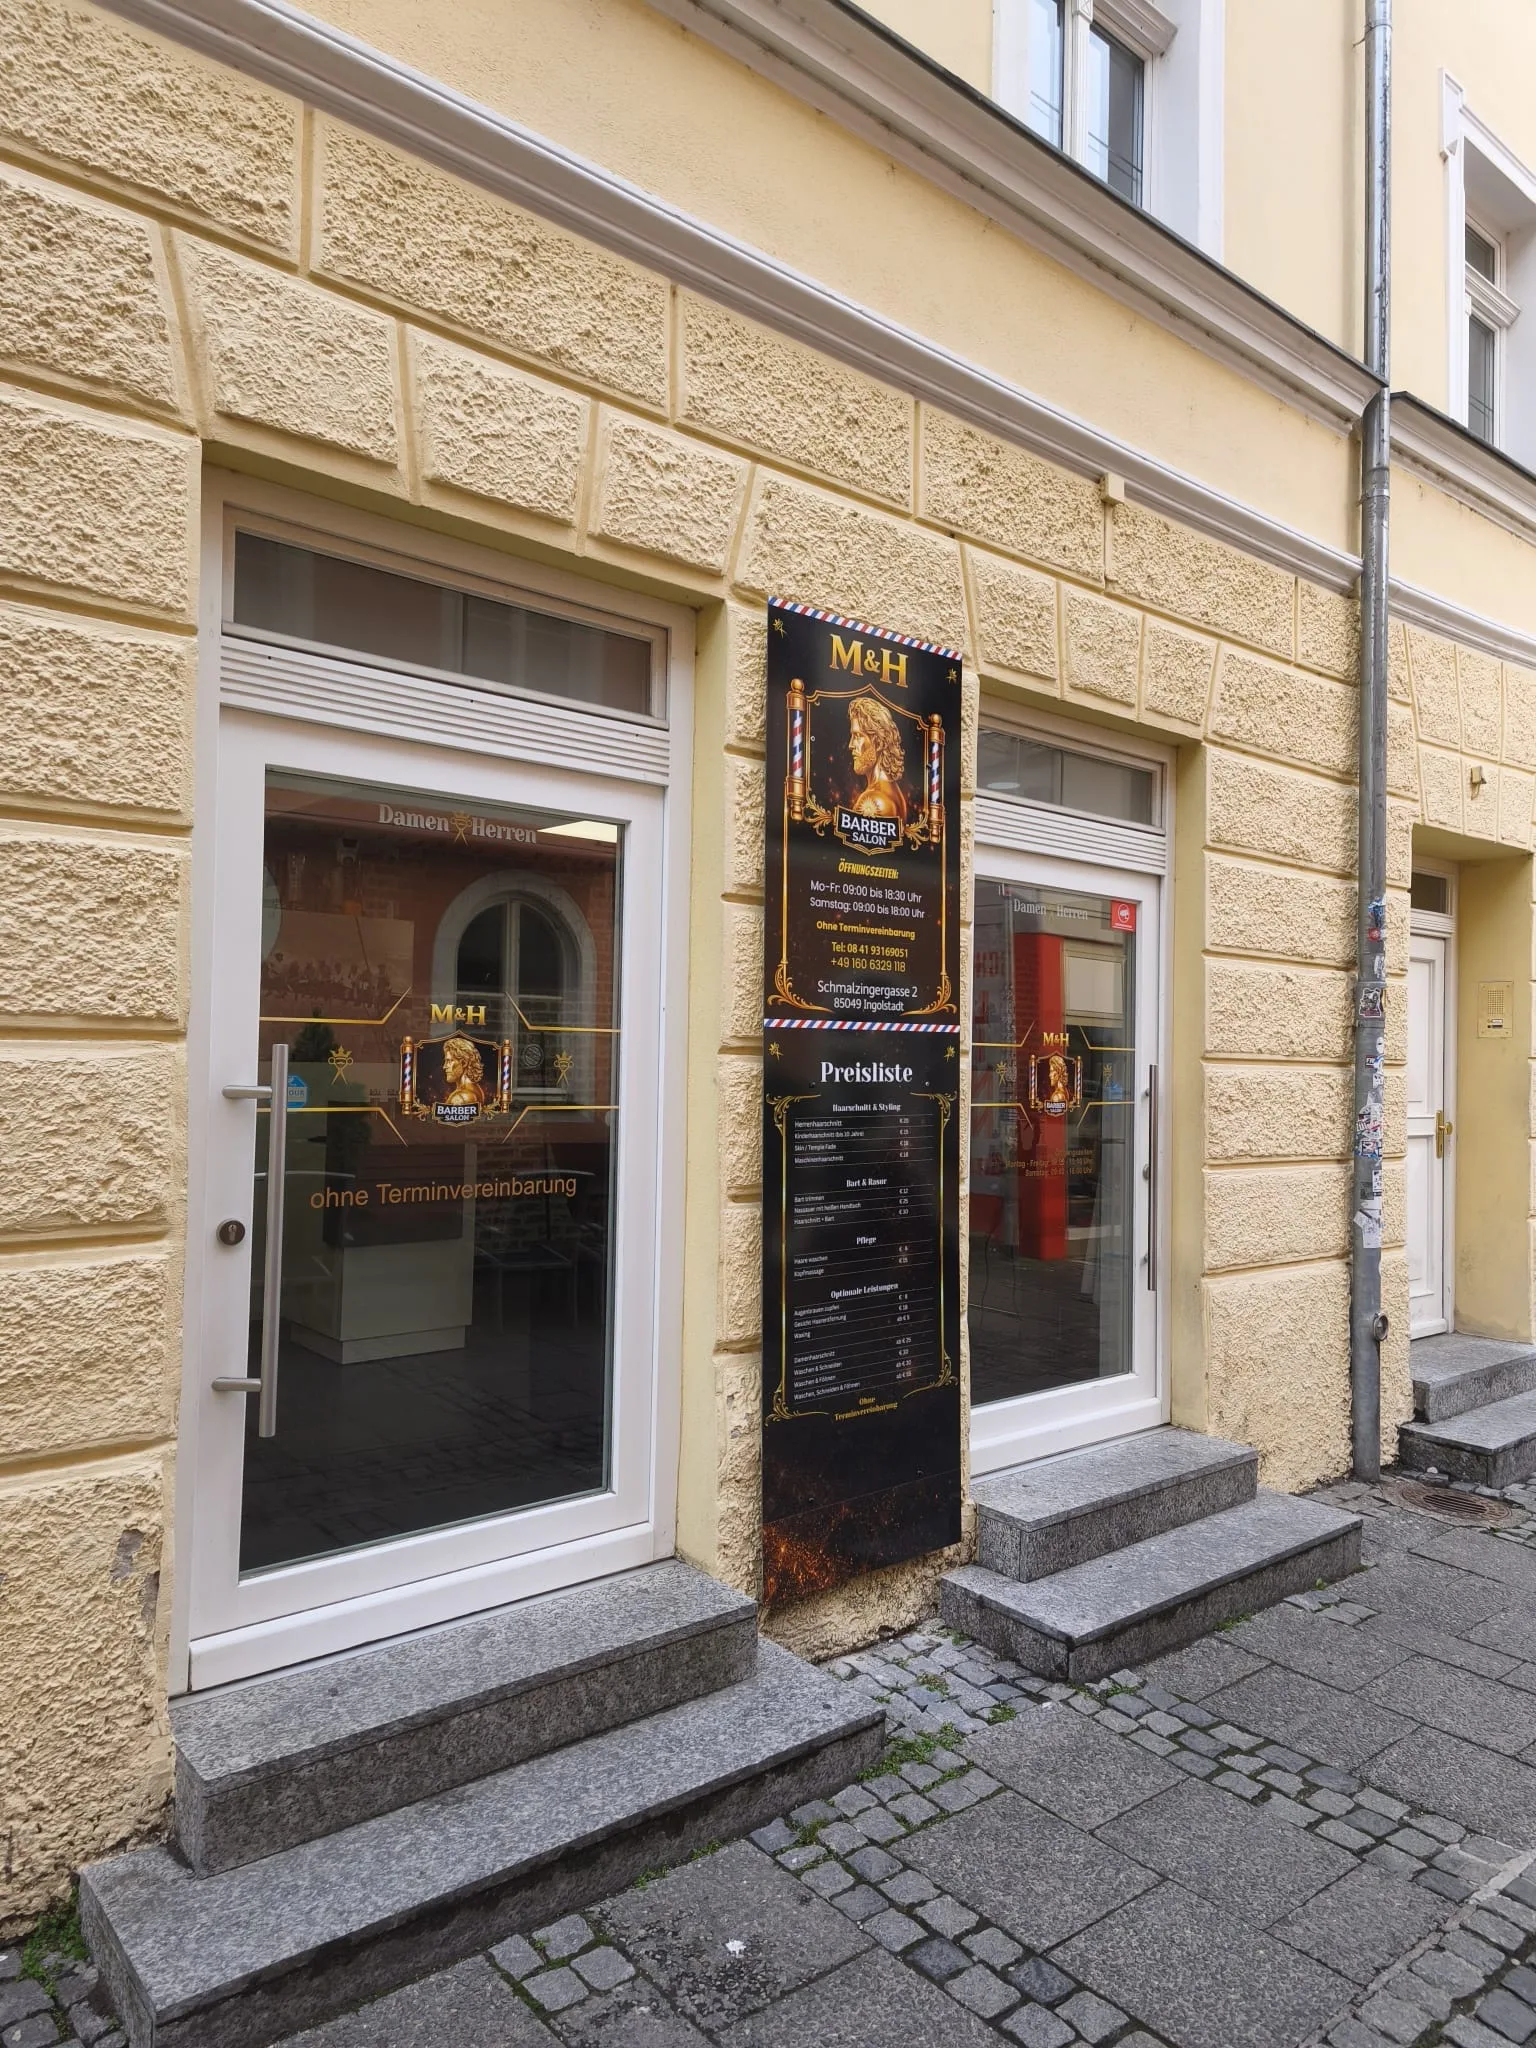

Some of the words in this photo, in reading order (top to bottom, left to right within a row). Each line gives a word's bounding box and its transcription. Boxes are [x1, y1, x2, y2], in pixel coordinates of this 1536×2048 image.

[829, 633, 908, 688] M&H
[379, 803, 449, 832] Damen
[472, 816, 537, 844] Herren
[841, 813, 896, 837] BARBER
[852, 831, 886, 846] SALON
[838, 858, 899, 880] ÖFFNUNGSZEITEN:
[843, 884, 868, 896] 09:00
[870, 886, 883, 898] bis
[884, 888, 906, 901] 18:30
[908, 891, 922, 904] Uhr
[810, 897, 852, 912] Samstag:
[853, 902, 876, 913] 09:00
[877, 904, 890, 914] bis
[890, 905, 910, 917] 18:00
[912, 908, 925, 919] Uhr
[1014, 898, 1047, 915] Damen
[1056, 904, 1088, 921] Herren
[816, 921, 838, 931] Ohne
[839, 922, 916, 941] Terminvereinbarung
[832, 941, 846, 953] Tel:
[848, 942, 858, 953] 08
[859, 944, 869, 954] 41
[870, 945, 908, 958] 93169051
[831, 958, 850, 968] +49
[852, 958, 867, 970] 160
[870, 960, 892, 972] 6329
[893, 962, 906, 973] 118
[817, 980, 910, 998] Schmalzingergasse
[912, 986, 918, 998] 2
[834, 997, 862, 1009] 85049
[864, 1000, 904, 1013] Ingolstadt
[430, 1003, 487, 1026] M&H
[1043, 1032, 1070, 1047] M&H
[820, 1061, 912, 1083] Preisliste
[437, 1105, 477, 1115] BARBER
[832, 1104, 871, 1112] Haarschnitt
[878, 1102, 901, 1112] Styling
[846, 1180, 860, 1188] Bart
[868, 1178, 887, 1186] Rasur
[310, 1188, 369, 1209] ohne
[376, 1177, 577, 1206] Terminvereinbarung
[856, 1236, 876, 1245] Pflege
[830, 1288, 862, 1299] Optionale
[863, 1283, 898, 1294] Leistungen
[859, 1397, 876, 1405] Ohne
[834, 1402, 898, 1421] Terminvereinbarung
